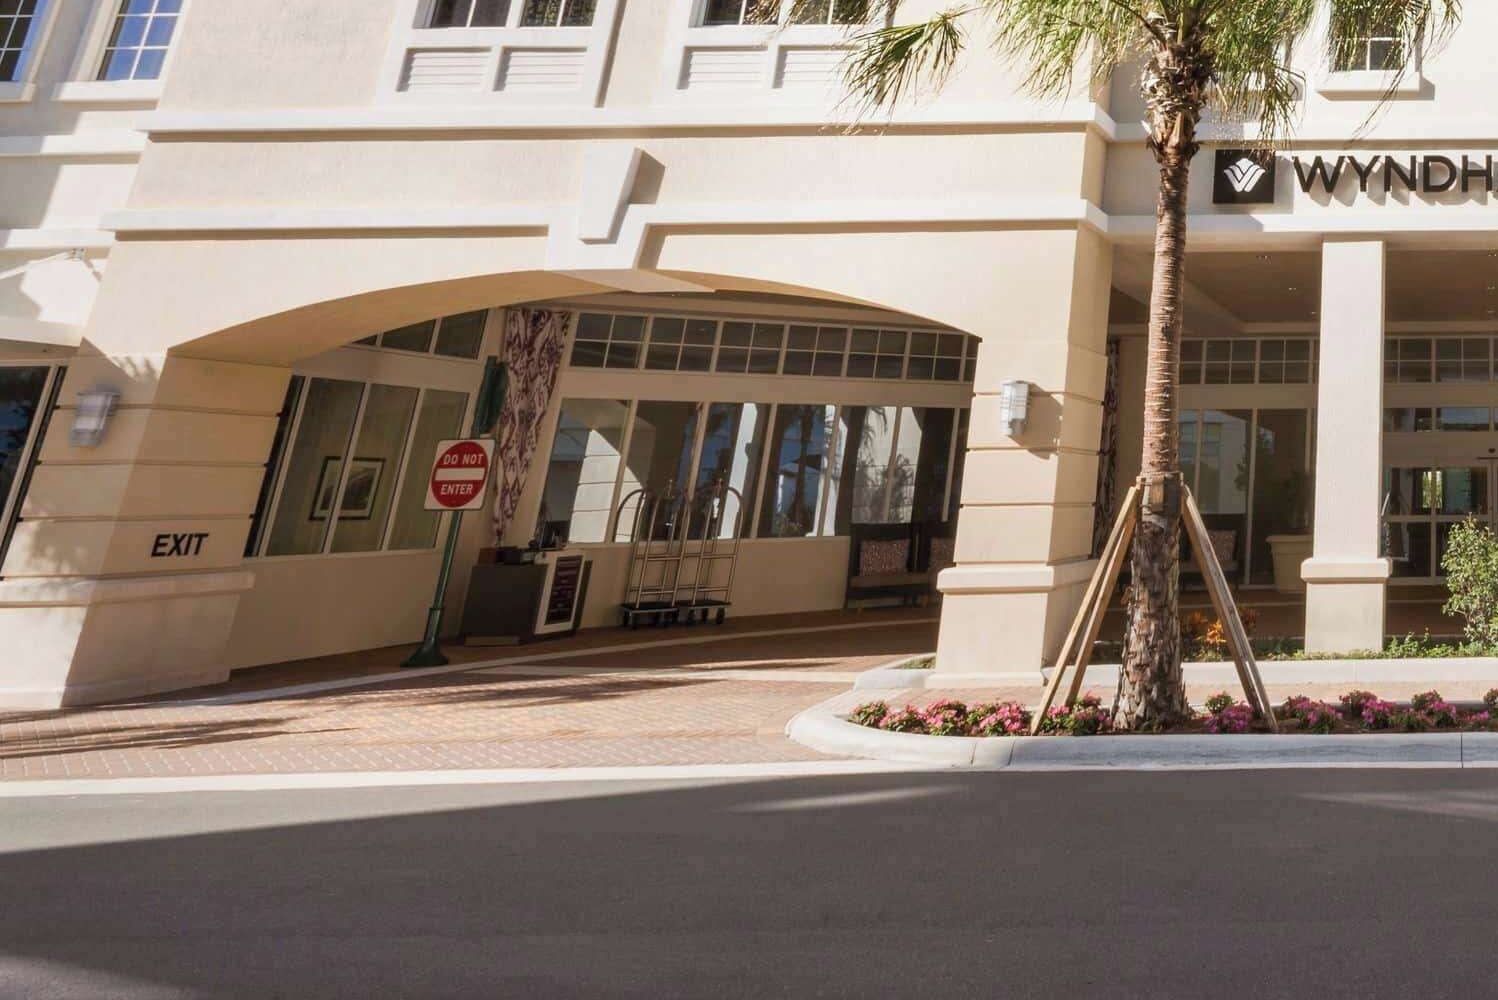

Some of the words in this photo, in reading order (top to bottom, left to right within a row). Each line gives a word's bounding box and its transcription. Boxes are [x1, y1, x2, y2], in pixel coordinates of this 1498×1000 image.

[443, 454, 459, 465] DO
[462, 453, 484, 465] NOT
[440, 484, 473, 495] ENTER
[151, 532, 209, 557] EXIT
